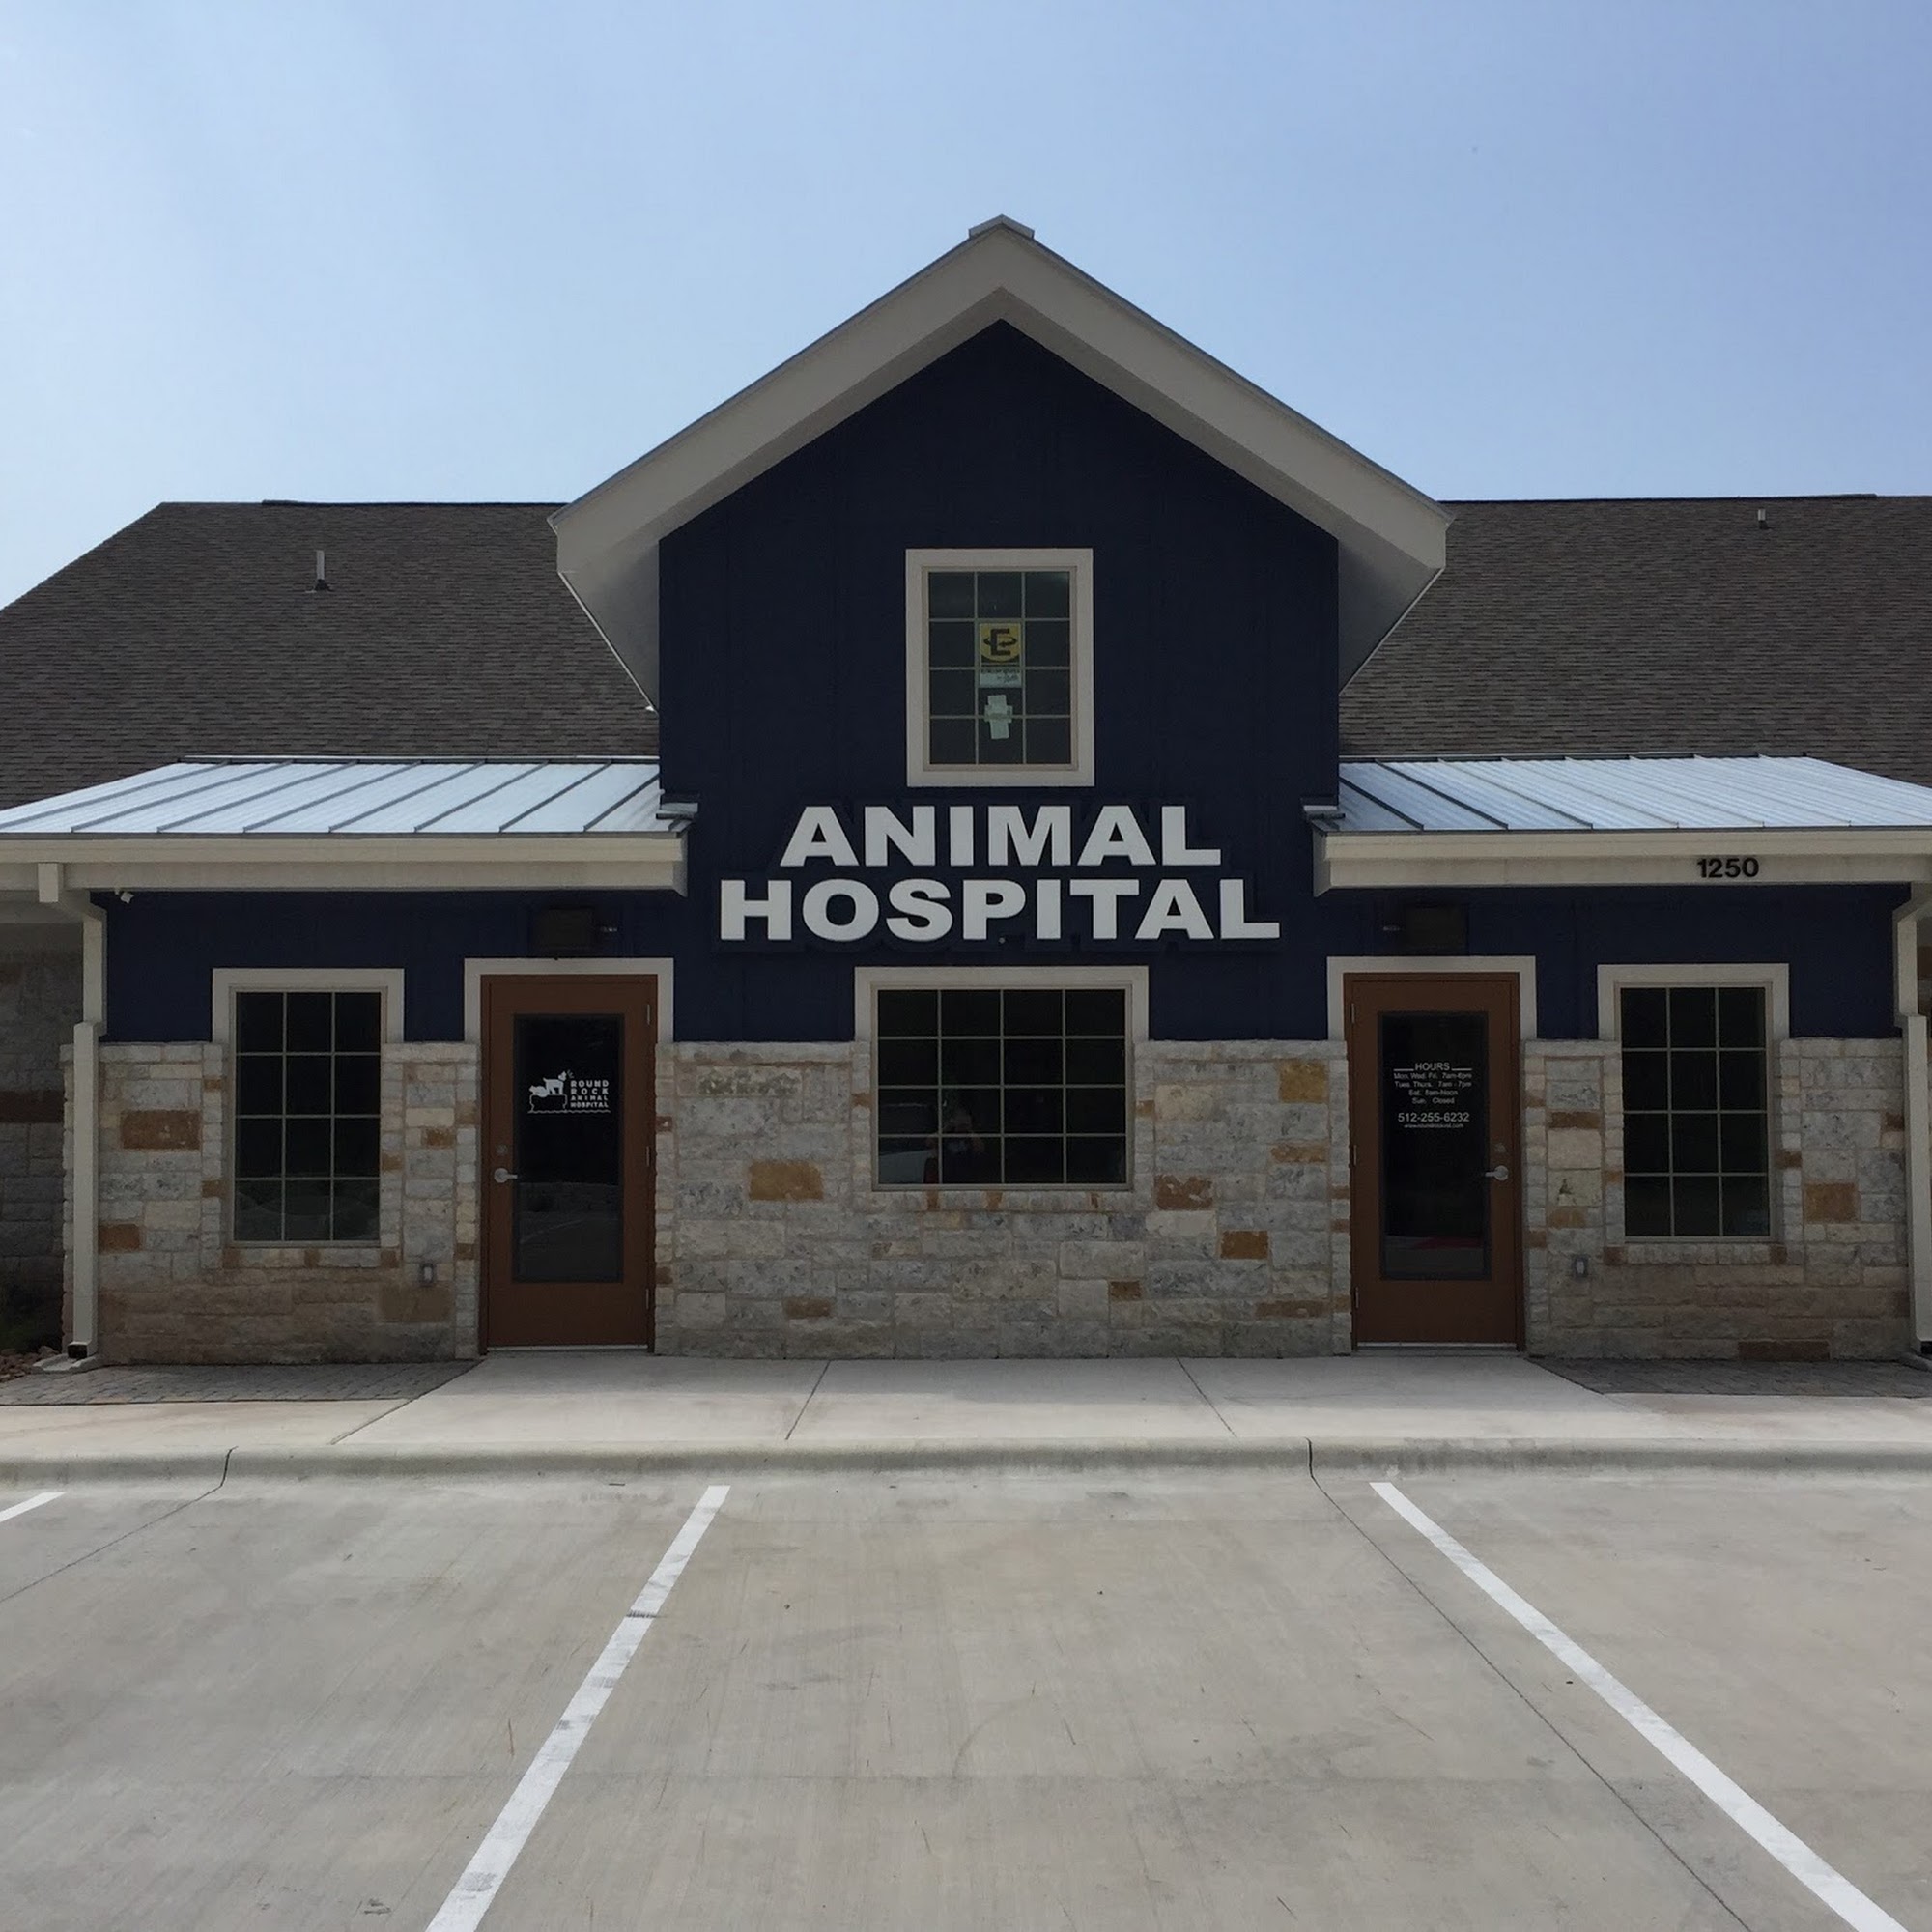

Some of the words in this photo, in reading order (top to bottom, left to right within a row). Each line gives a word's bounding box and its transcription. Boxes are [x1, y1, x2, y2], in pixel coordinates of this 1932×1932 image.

[780, 805, 1221, 867] ANIMAL
[1697, 857, 1760, 878] 1250
[720, 878, 1280, 941] HOSPITAL
[1414, 1062, 1450, 1071] HOURS
[1397, 1112, 1470, 1122] 512-255-6232
